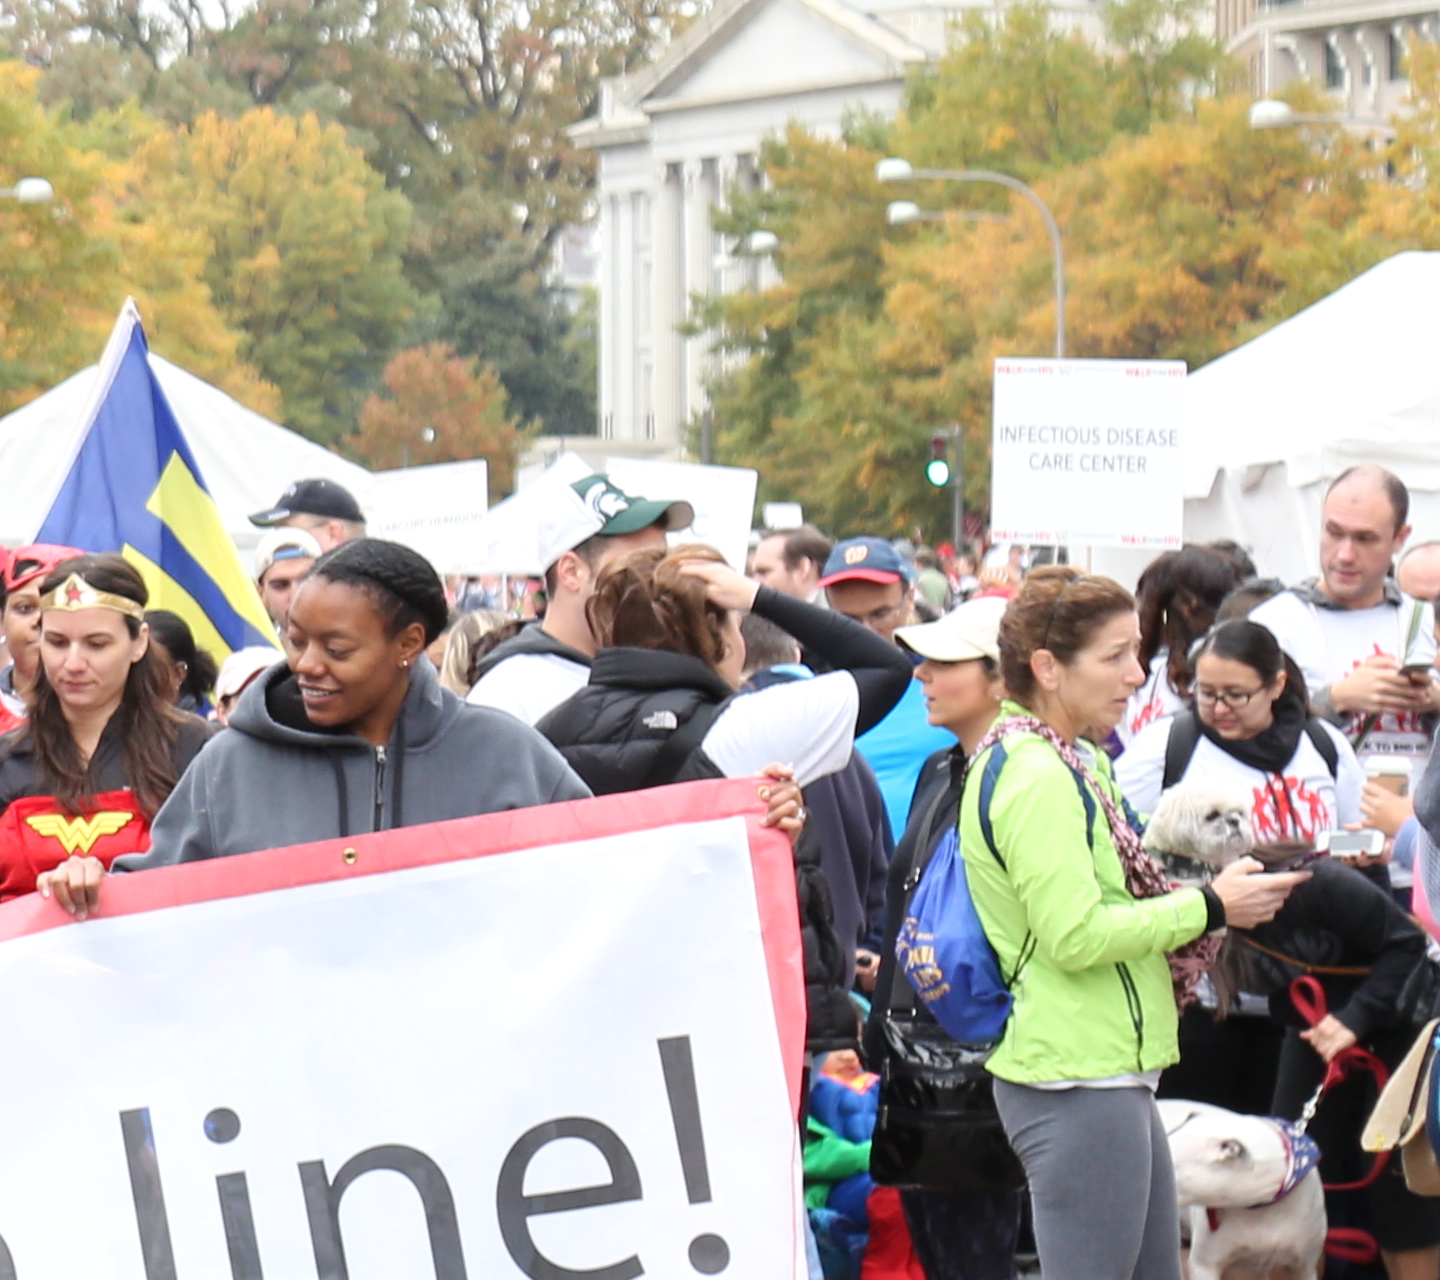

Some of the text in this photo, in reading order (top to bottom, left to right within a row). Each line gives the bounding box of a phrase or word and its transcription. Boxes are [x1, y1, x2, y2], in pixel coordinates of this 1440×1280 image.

[999, 425, 1179, 447] INFECTIOUS DISEASE
[1029, 452, 1147, 474] CARE CENTER
